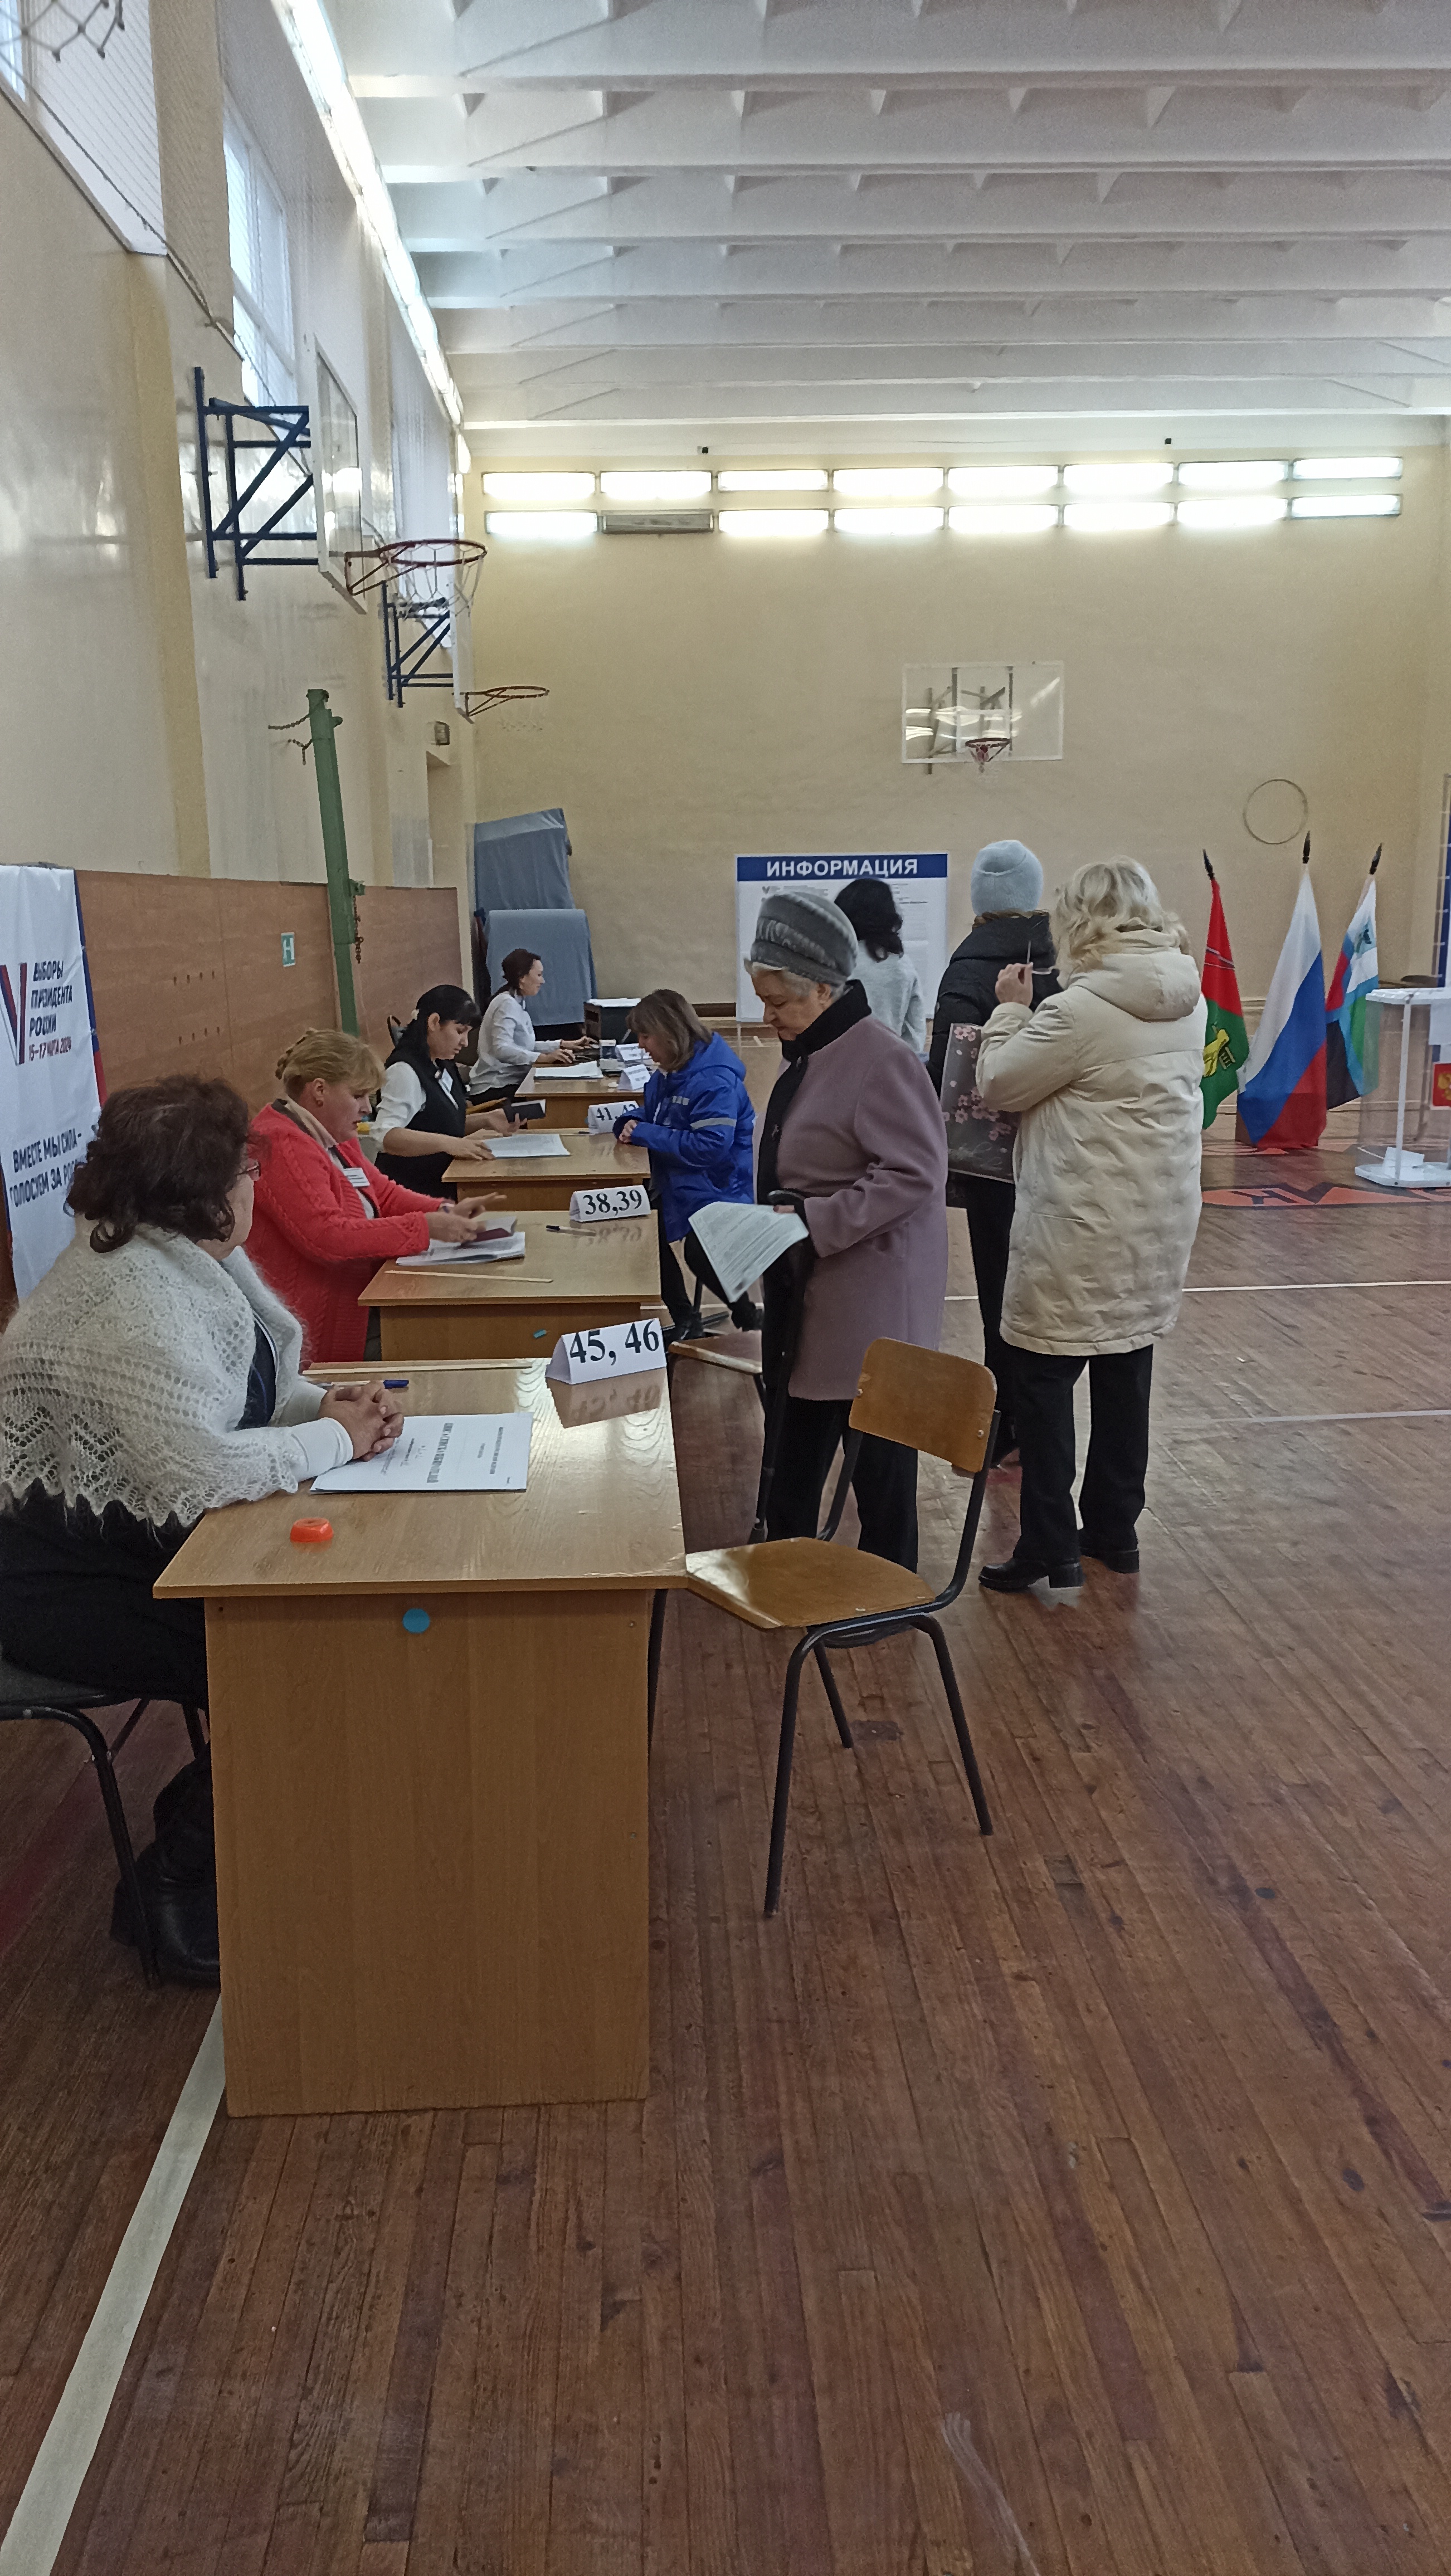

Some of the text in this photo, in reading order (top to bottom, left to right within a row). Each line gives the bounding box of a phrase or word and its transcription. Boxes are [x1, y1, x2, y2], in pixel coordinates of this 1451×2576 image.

[766, 858, 918, 878] ИНФОРМАЦИЯ
[33, 960, 64, 981] ВЫБОРЫ
[50, 1167, 62, 1190] ЗА
[583, 1189, 642, 1217] 38,39
[569, 1319, 659, 1365] 45, 46
